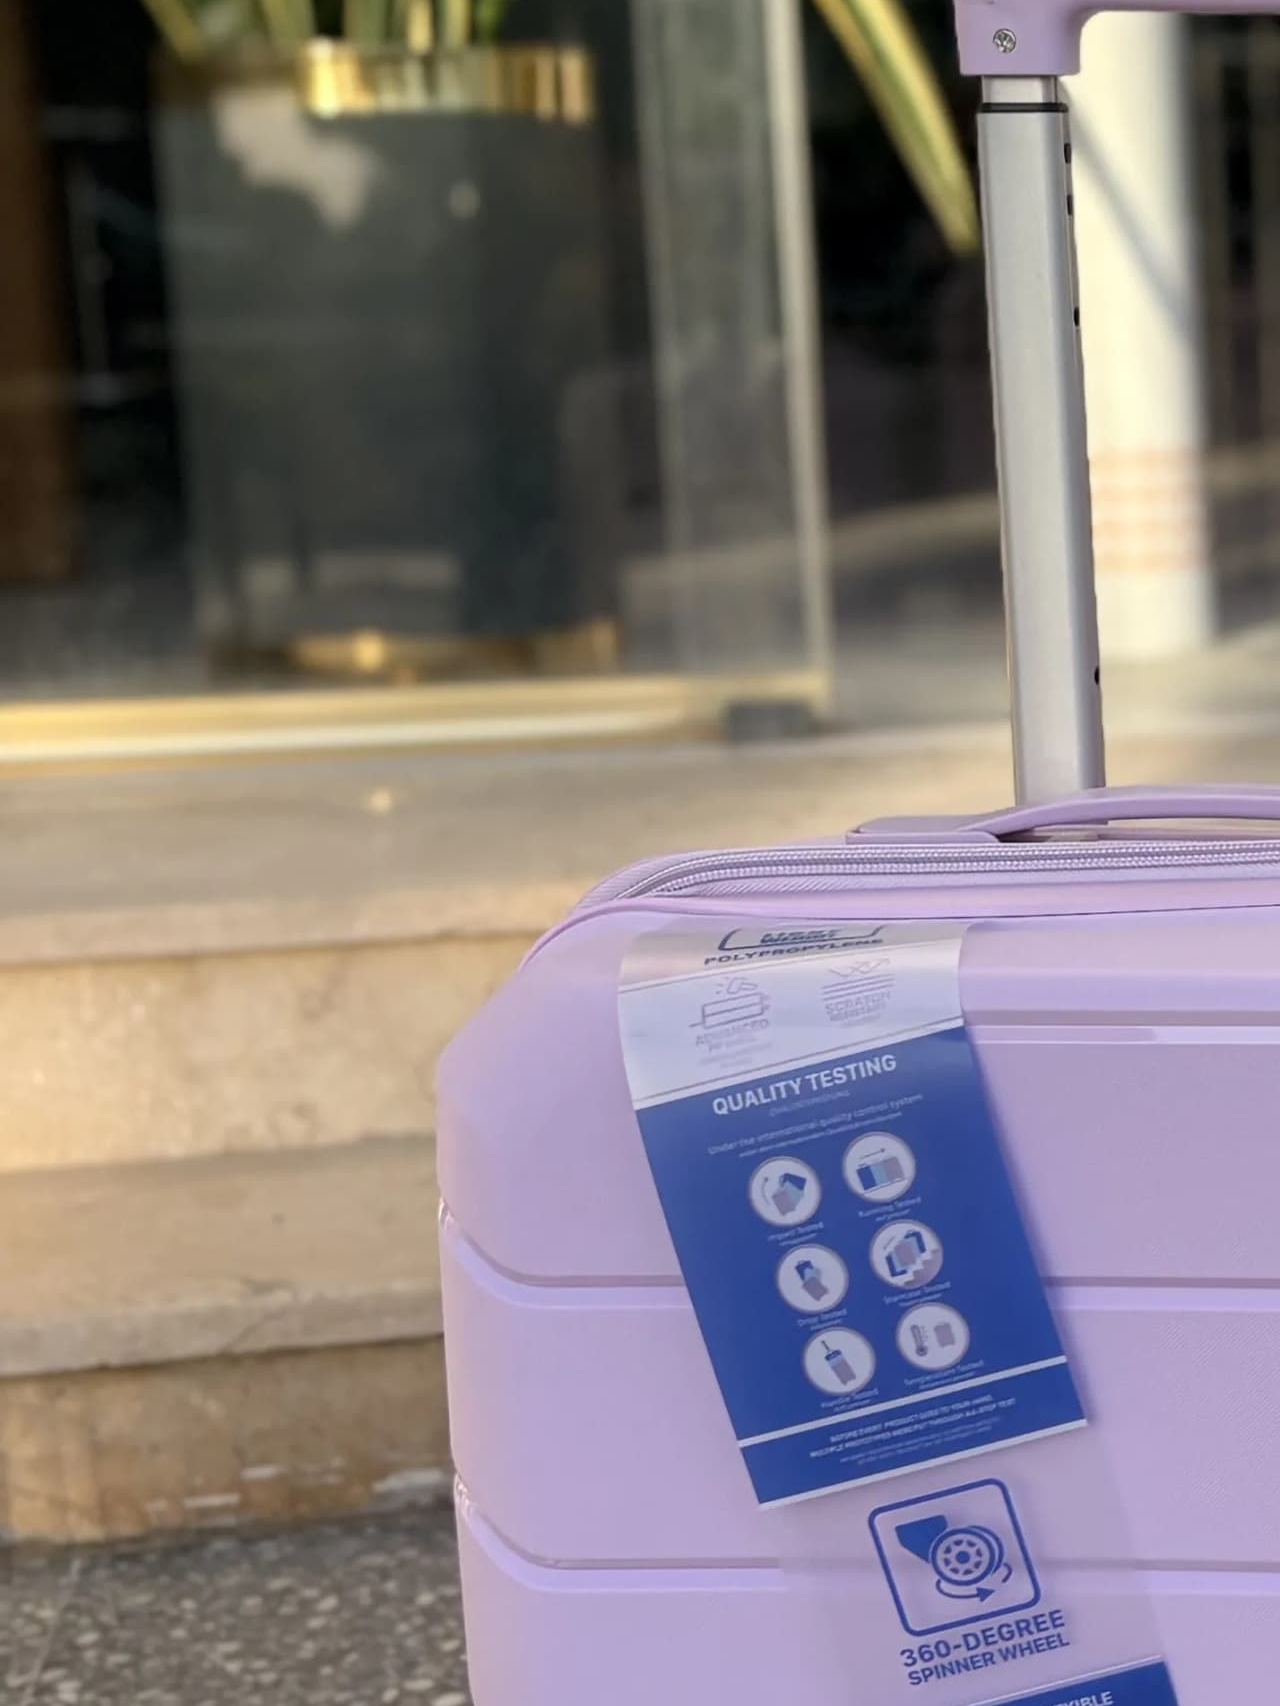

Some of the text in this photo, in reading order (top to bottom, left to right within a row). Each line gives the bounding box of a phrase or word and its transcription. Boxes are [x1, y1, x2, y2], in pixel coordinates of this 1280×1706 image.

[704, 937, 884, 966] POLYPROPYLENE
[712, 1078, 802, 1116] QUALITY
[805, 1054, 897, 1091] TESTING
[899, 1609, 1066, 1668] 360-DEGREE
[908, 1631, 1071, 1686] SPINNER WHEEL
